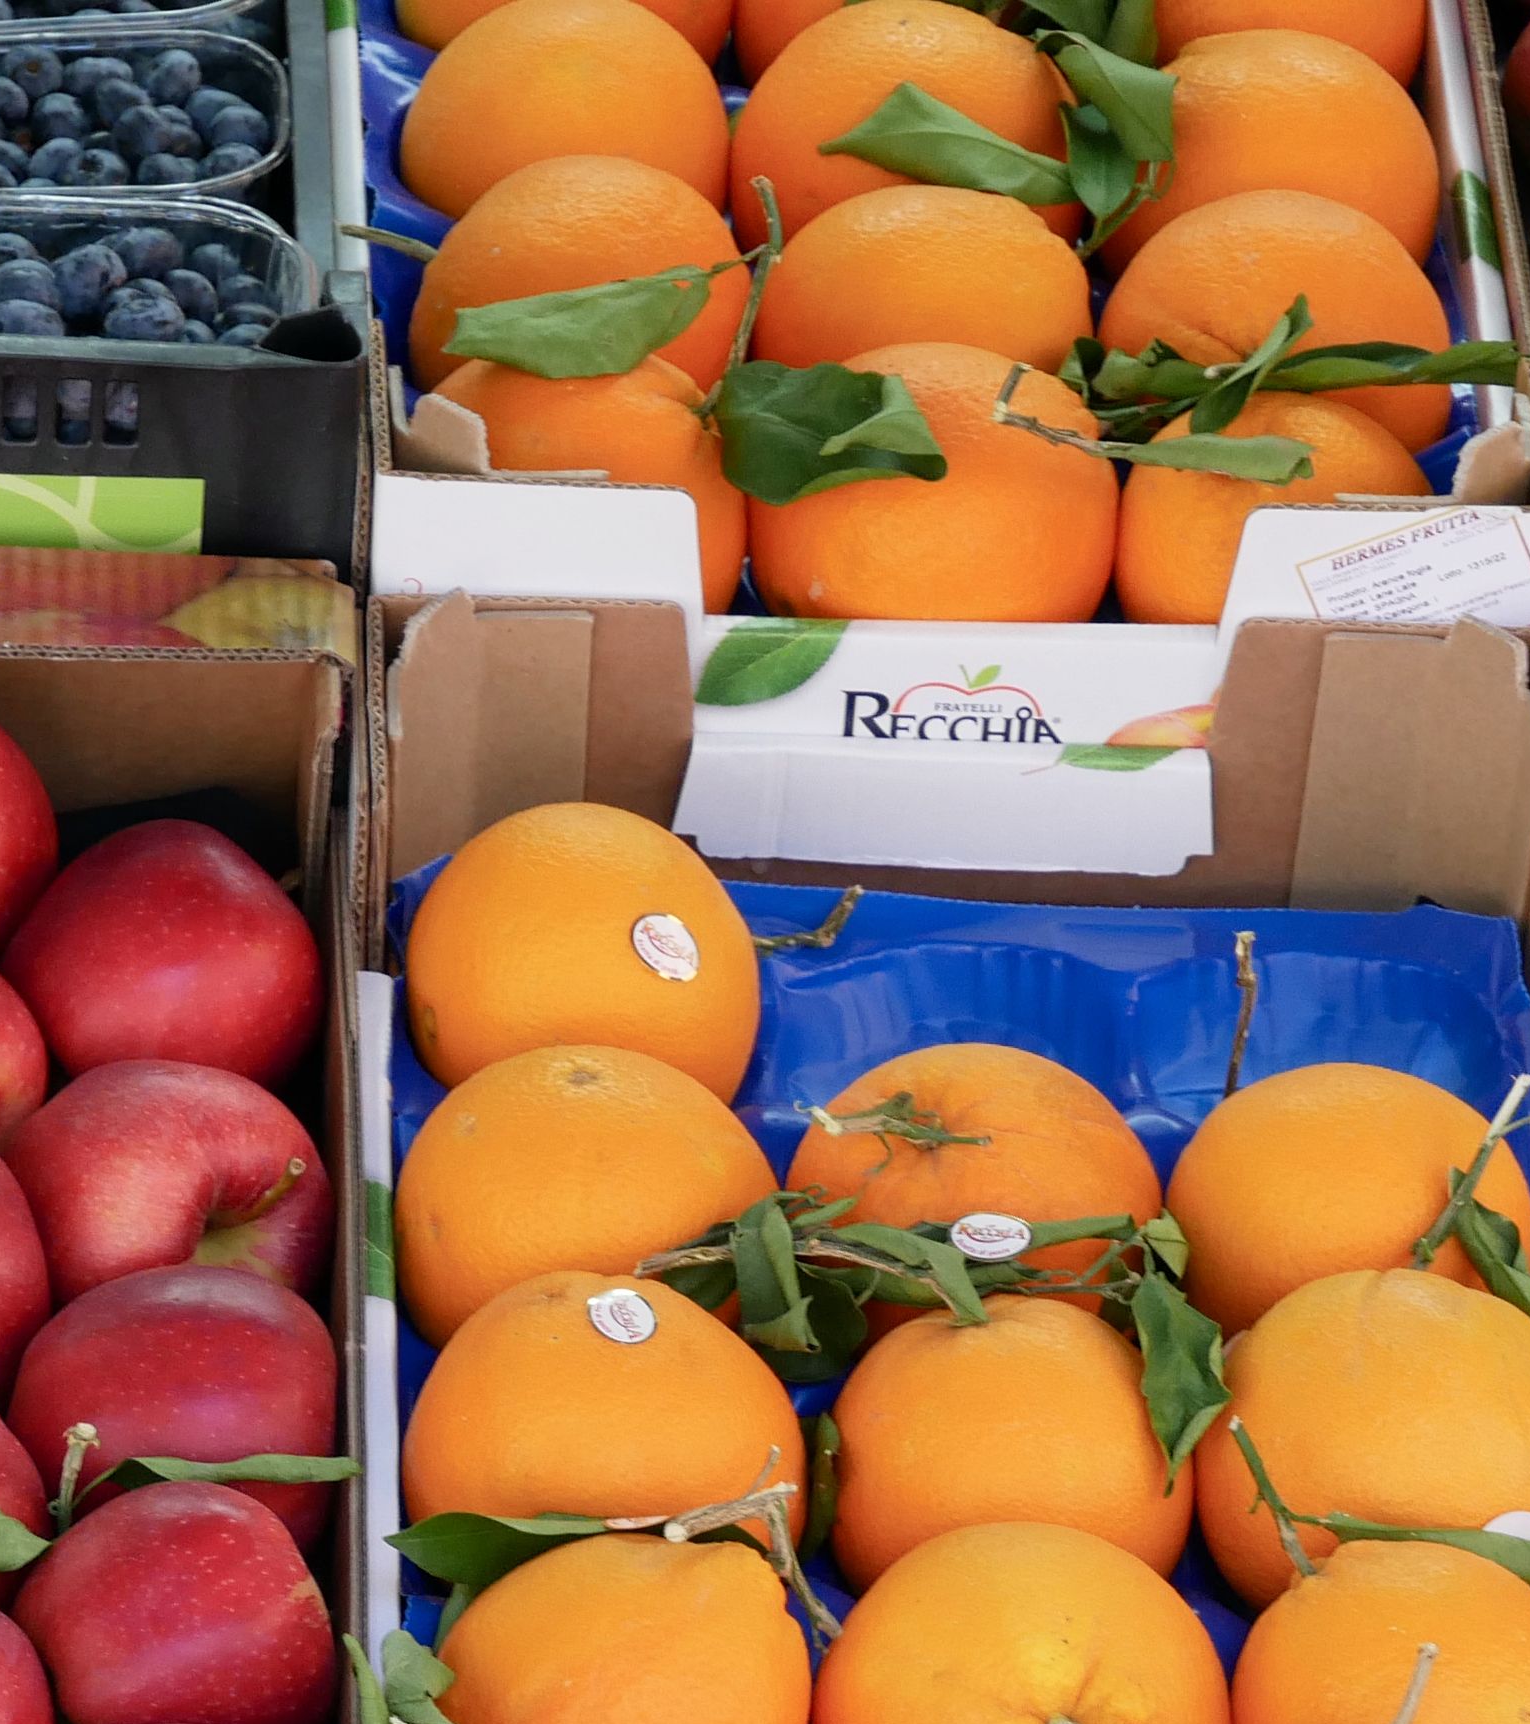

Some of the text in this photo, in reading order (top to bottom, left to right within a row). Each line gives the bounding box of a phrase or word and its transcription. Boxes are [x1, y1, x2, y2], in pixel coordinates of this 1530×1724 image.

[1331, 534, 1407, 571] HERMES
[1411, 510, 1481, 544] FRUTTA
[842, 690, 1063, 744] RECCHIA
[934, 702, 1003, 713] FRATELLI
